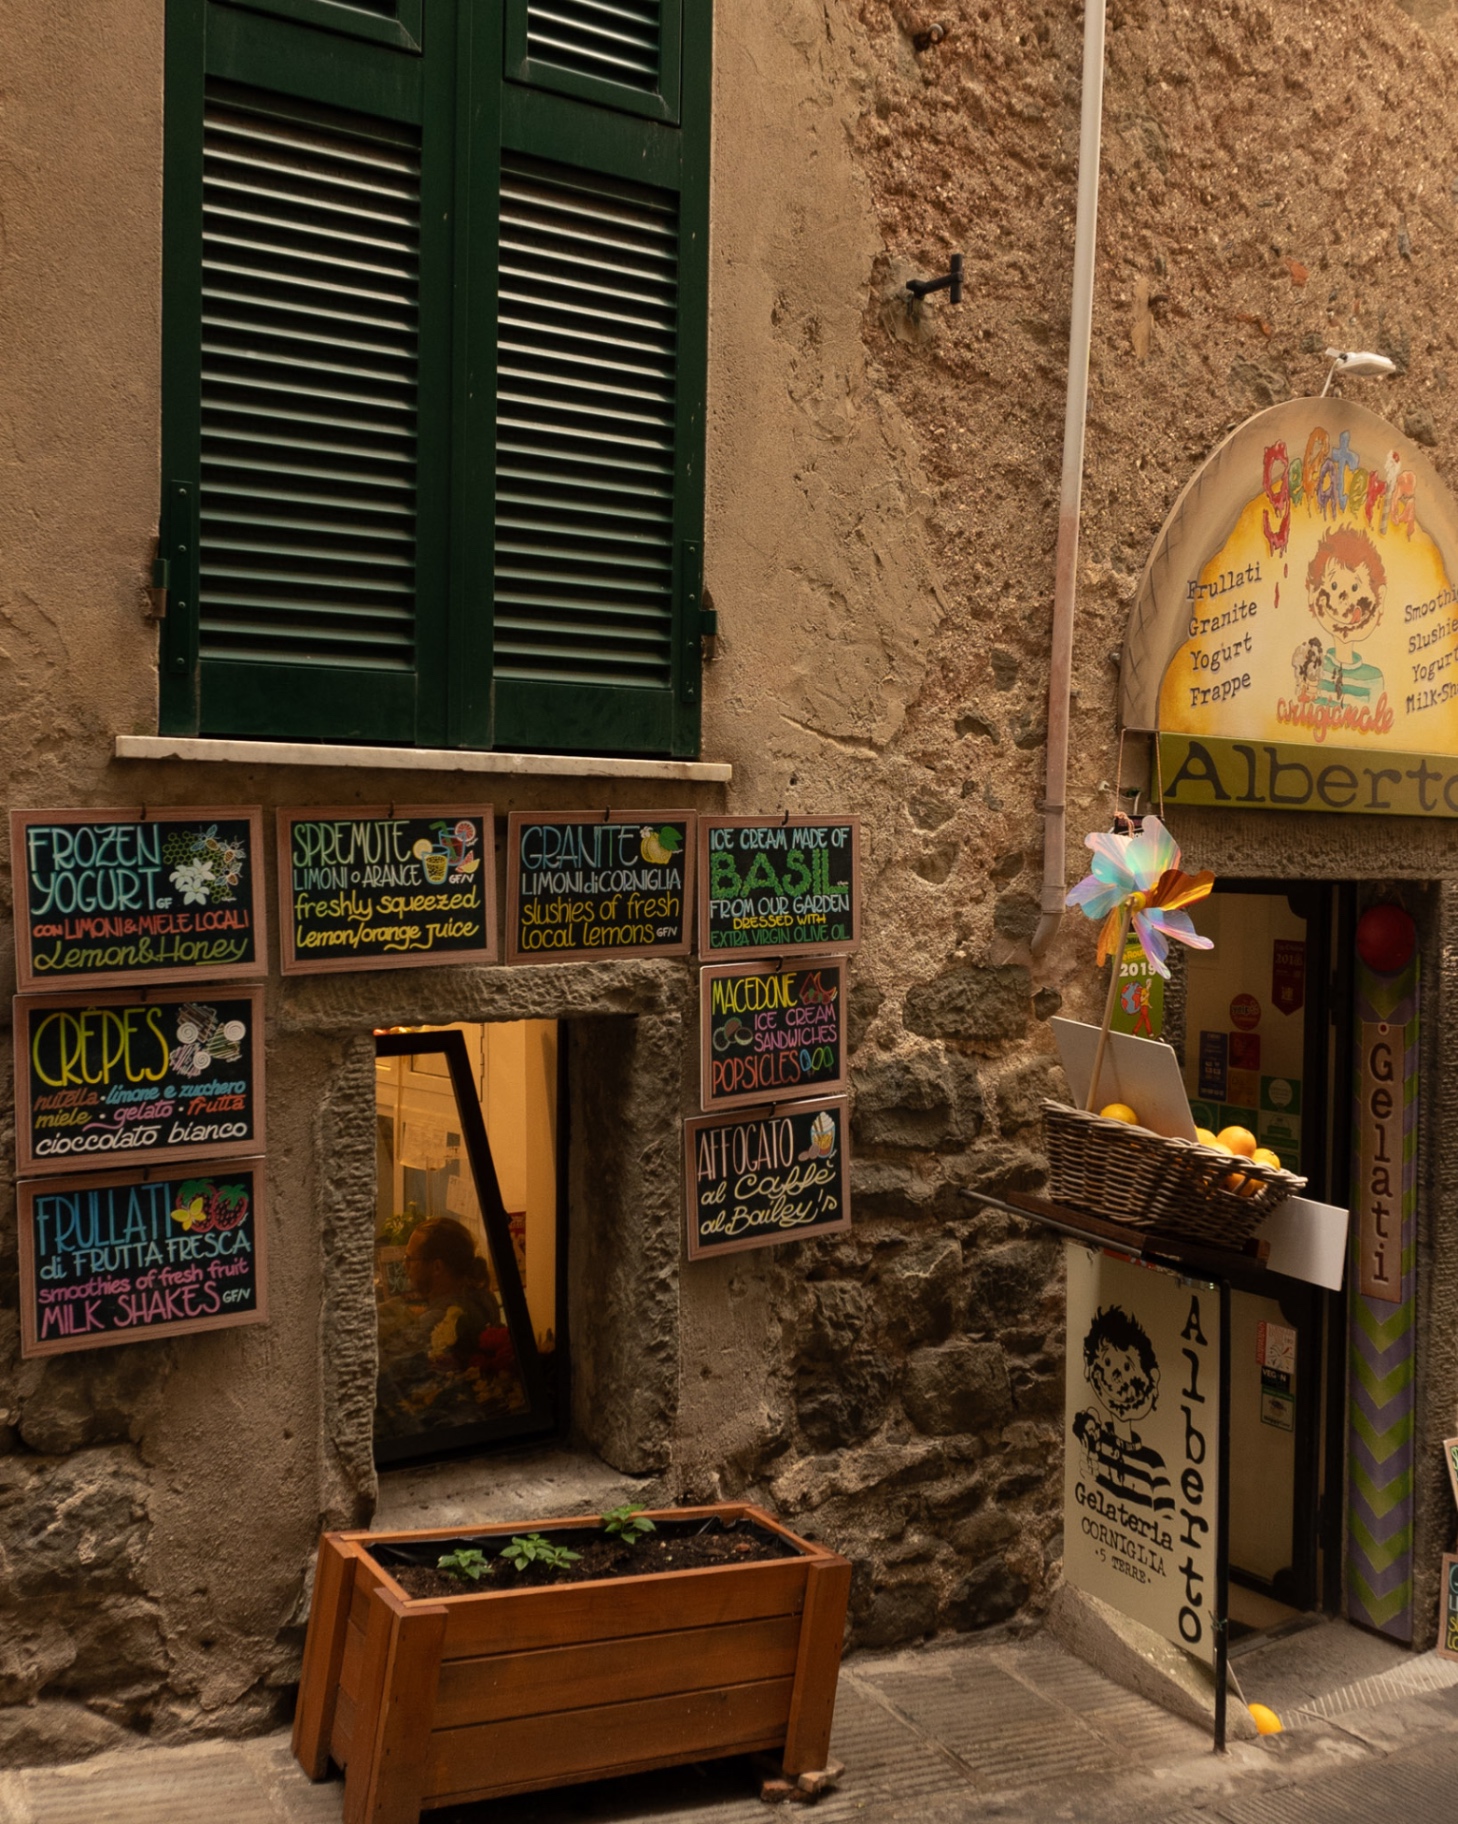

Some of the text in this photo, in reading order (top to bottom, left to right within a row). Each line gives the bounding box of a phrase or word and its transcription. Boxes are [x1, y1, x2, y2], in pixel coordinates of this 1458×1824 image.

[1186, 560, 1262, 600] Frullati
[1188, 599, 1257, 637] Granite
[1190, 631, 1252, 672] Yogurt
[1190, 672, 1251, 706] Frappe
[1277, 685, 1394, 743] artigianale
[27, 824, 161, 871] FROZEN
[293, 820, 411, 867] SPREMUTE
[521, 825, 640, 869] GRANITE
[711, 828, 849, 850] ICE CREAM MADE OF
[31, 867, 172, 915] YOGURT GF
[294, 867, 347, 890] LIMONI
[362, 864, 421, 888] ARANCE
[522, 871, 583, 895] LIMONI
[600, 868, 681, 892] CORNIGLIA
[711, 848, 849, 899] BASIL
[195, 910, 248, 931] LOCALI
[294, 884, 480, 921] freshly squeezed
[522, 891, 679, 925] slushies of fresh
[710, 895, 849, 919] FROM OUR GARDEN
[733, 914, 826, 929] DRESSED WITH
[522, 922, 576, 949] local
[583, 922, 655, 946] lemons
[710, 924, 850, 947] EXTRA VIRGIN OLIVE OIL
[712, 973, 797, 1015] MACEDONE
[754, 1003, 836, 1030] ICE CREAM
[754, 1025, 837, 1052] SANDWICHES
[713, 1050, 800, 1094] POPSICLES
[34, 1079, 246, 1111] nutella limone e zucchero
[35, 1095, 246, 1132] miele gelato frutta
[36, 1121, 248, 1155] cioccolato bianco
[698, 1118, 794, 1181] AFFOGATO
[1369, 1041, 1395, 1284] Gelati
[700, 1188, 838, 1235] al Bailey's
[701, 1181, 727, 1205] al
[36, 1183, 171, 1256] FRULLATI
[40, 1230, 251, 1279] di FRUTTA FRESCA
[38, 1257, 249, 1304] smoothies of fresh fruit
[41, 1299, 105, 1338] MILK
[113, 1281, 221, 1326] SHAKES
[1179, 1295, 1209, 1644] Alberto
[1075, 1482, 1173, 1551] Gelateria
[1082, 1517, 1166, 1577] CORNIGLIA
